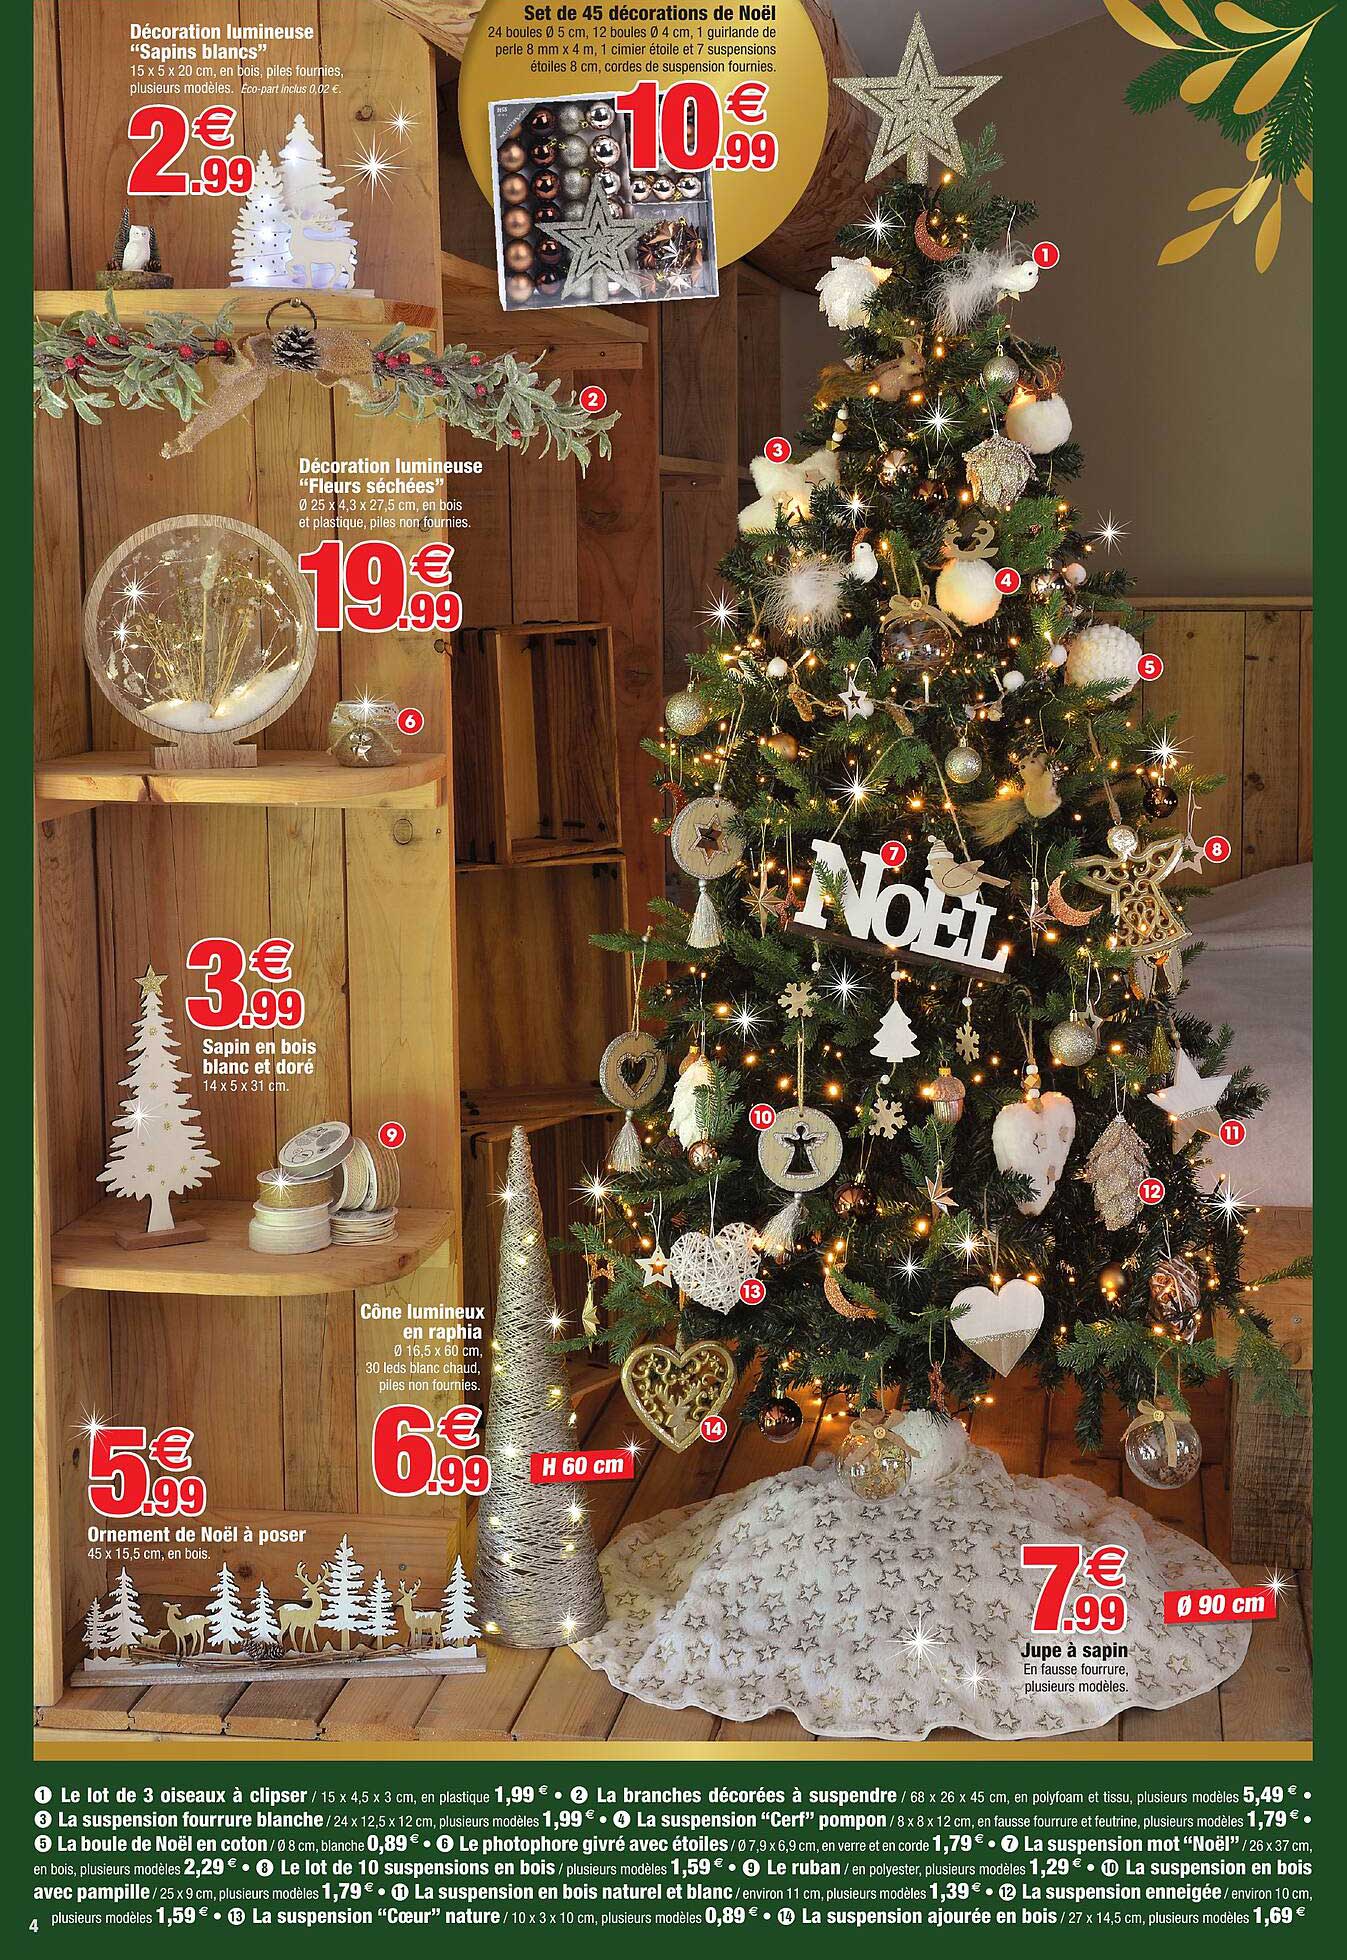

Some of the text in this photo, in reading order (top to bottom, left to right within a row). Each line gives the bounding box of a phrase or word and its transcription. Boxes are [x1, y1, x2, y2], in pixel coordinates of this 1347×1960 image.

[523, 4, 776, 21] Set de 45 décorations de Noël
[129, 23, 315, 40] Décoration lumineuse
[130, 43, 268, 62] “Sapins blancs”
[529, 59, 777, 75] étoiles 8 cm, cordes de suspension fournies.
[129, 80, 342, 97] plusieurs modèles. Éco-part inclus 0,02 €.
[299, 457, 483, 474] Décoration lumineuse
[299, 477, 445, 494] “Fleurs séchées”
[298, 515, 472, 531] et plastique, piles non fournies.
[202, 1038, 317, 1058] Sapin en bois
[202, 1058, 315, 1075] blanc et doré
[360, 1303, 486, 1320] Cône lumineux
[402, 1323, 483, 1343] en raphia
[378, 1378, 481, 1394] piles non fournies.
[541, 1456, 624, 1477] H 60 cm
[87, 1525, 307, 1546] Ornement de Noël à poser
[1199, 1594, 1225, 1615] 90
[1232, 1595, 1265, 1614] cm
[1020, 1641, 1128, 1661] Jupe à sapin
[1023, 1662, 1129, 1677] En fausse fourrure,
[1024, 1679, 1129, 1695] plusieurs modèles.
[60, 1786, 309, 1807] Le lot de 3 oiseaux à clipser
[596, 1786, 898, 1807] La branches décorées à suspendre
[1136, 1784, 1298, 1807] plusieurs modèles 5,49 €
[58, 1810, 324, 1831] La suspension fourrure blanche
[636, 1811, 887, 1831] La suspension “Cerf” pompon
[993, 1814, 1141, 1830] fausse fourrure et feutrine,
[57, 1835, 268, 1852] La boule de Noël en coton
[459, 1835, 729, 1855] Le photophore givré avec étoiles
[1023, 1835, 1240, 1855] La suspension mot “Noël”
[280, 1858, 556, 1879] Le lot de 10 suspensions en bois
[767, 1859, 841, 1876] Le ruban
[851, 1857, 1083, 1879] en polyester, plusieurs modèles 1,29 €
[33, 1883, 151, 1903] avec pampille
[414, 1883, 734, 1903] La suspension en bois naturel et blanc
[1230, 1887, 1313, 1902] environ 10 cm,
[28, 1918, 40, 1933] 4
[252, 1907, 501, 1928] La suspension “Cœur” nature
[801, 1907, 1058, 1928] La suspension ajourée en bois
